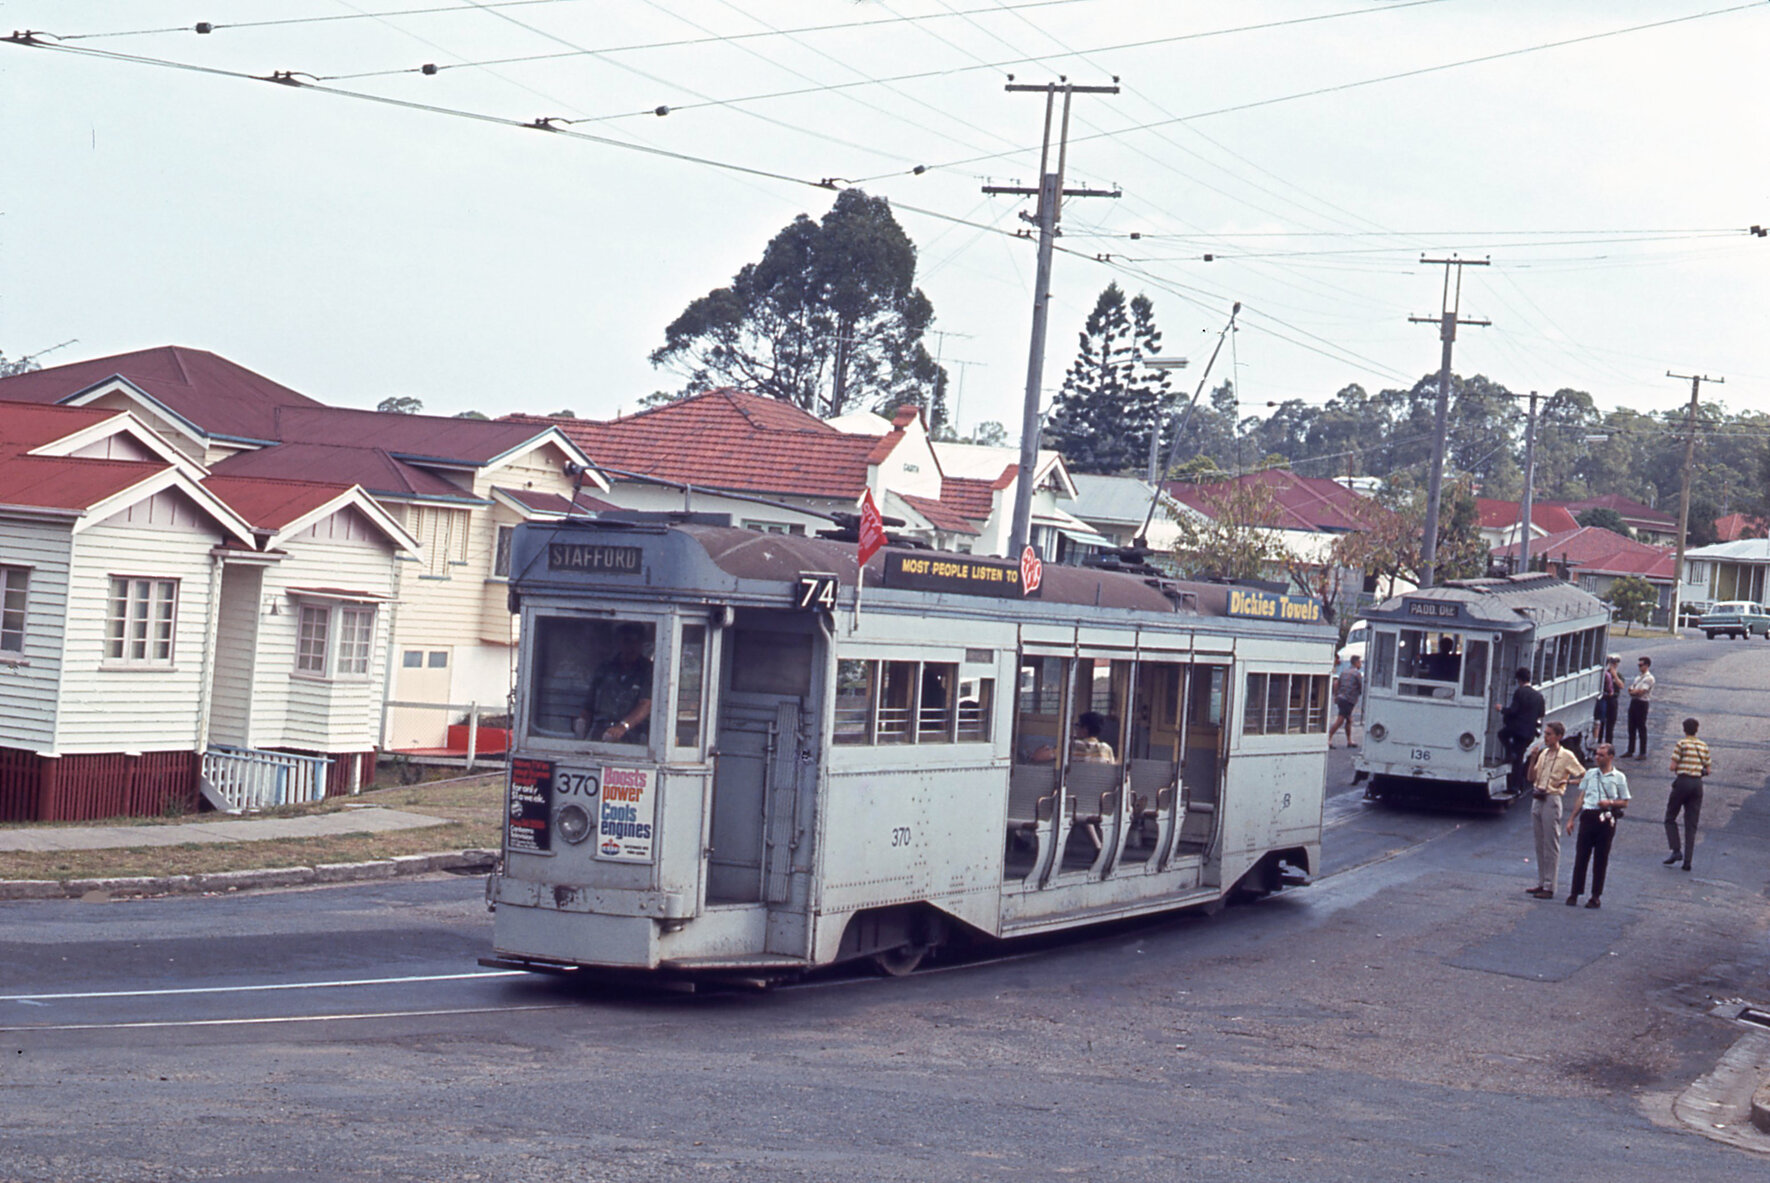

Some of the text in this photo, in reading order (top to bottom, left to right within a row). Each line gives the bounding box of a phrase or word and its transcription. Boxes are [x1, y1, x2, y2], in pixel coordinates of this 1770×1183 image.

[553, 547, 636, 568] STAFFORD
[902, 558, 1018, 583] MOST PEOPLE LISTEN TO
[801, 578, 834, 608] 74
[1230, 590, 1319, 621] Dickies Towels
[1410, 748, 1431, 761] 136
[557, 773, 598, 796] 370
[603, 766, 647, 788] Boosts
[602, 785, 643, 803] power
[601, 803, 637, 821] Cools
[601, 820, 651, 839] engines
[891, 826, 911, 848] 370
